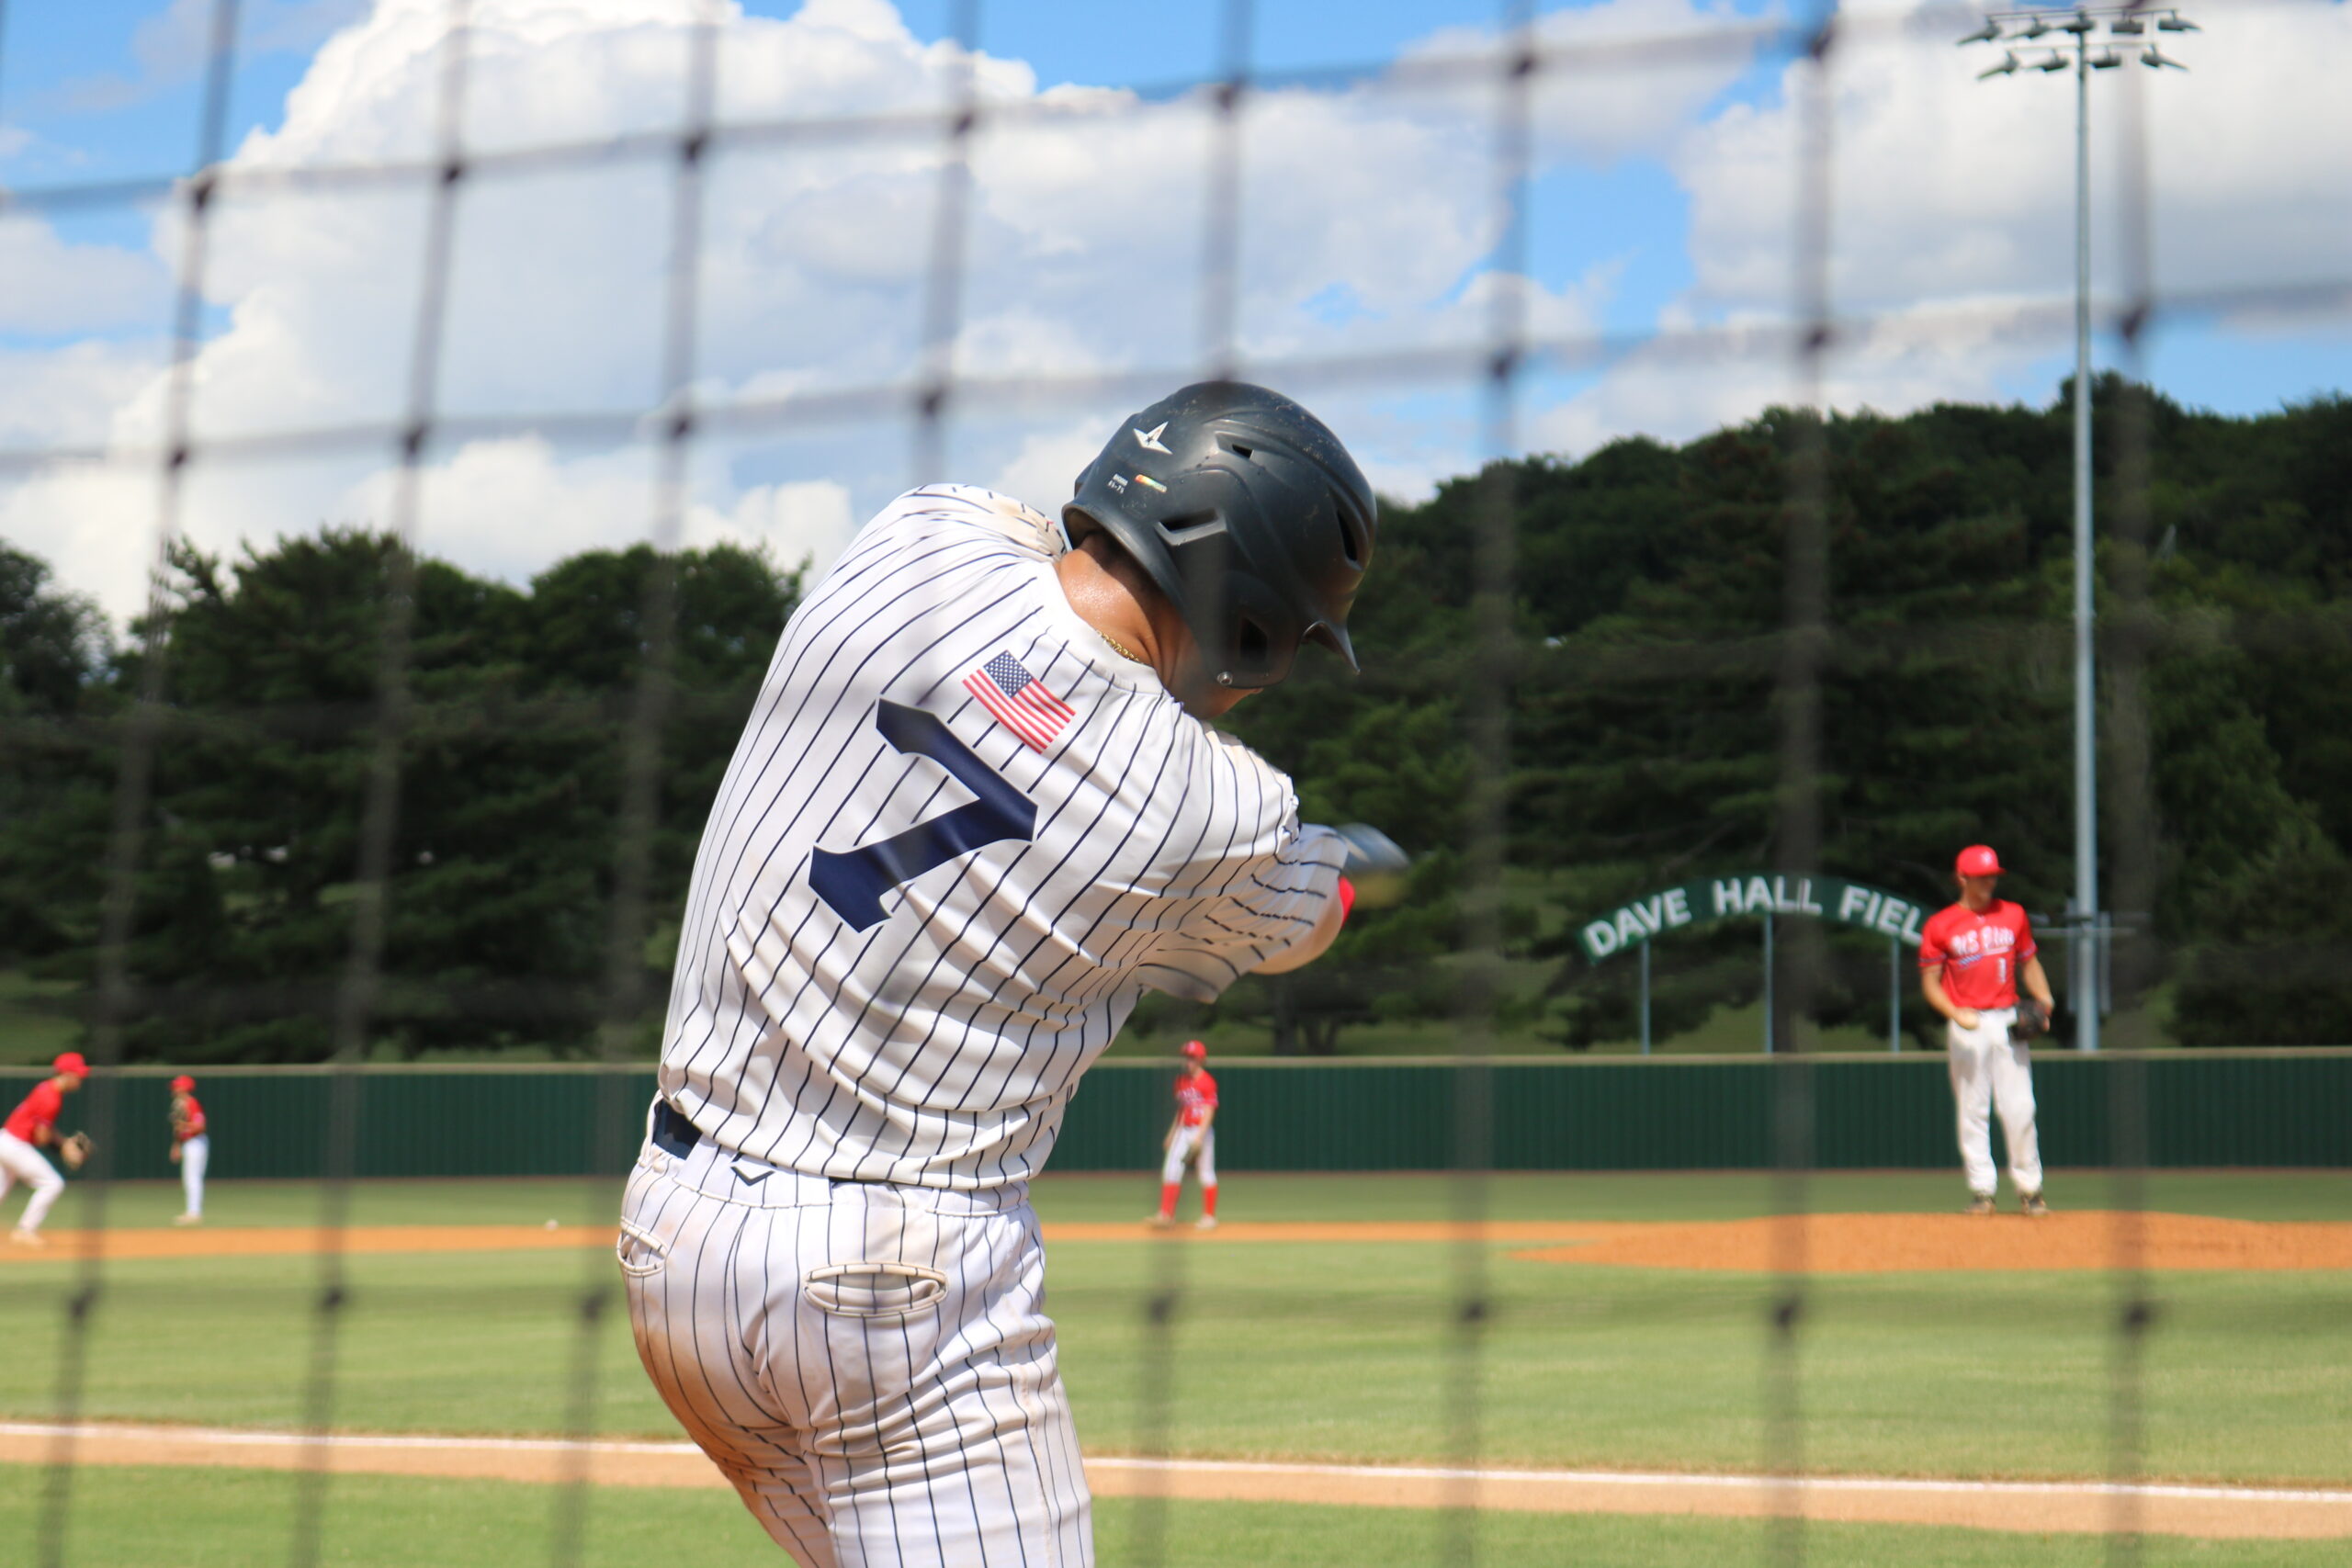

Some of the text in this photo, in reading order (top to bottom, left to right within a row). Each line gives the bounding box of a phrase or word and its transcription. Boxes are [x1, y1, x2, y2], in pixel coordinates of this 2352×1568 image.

[1583, 875, 1923, 957] DAVE HALL FIEL
